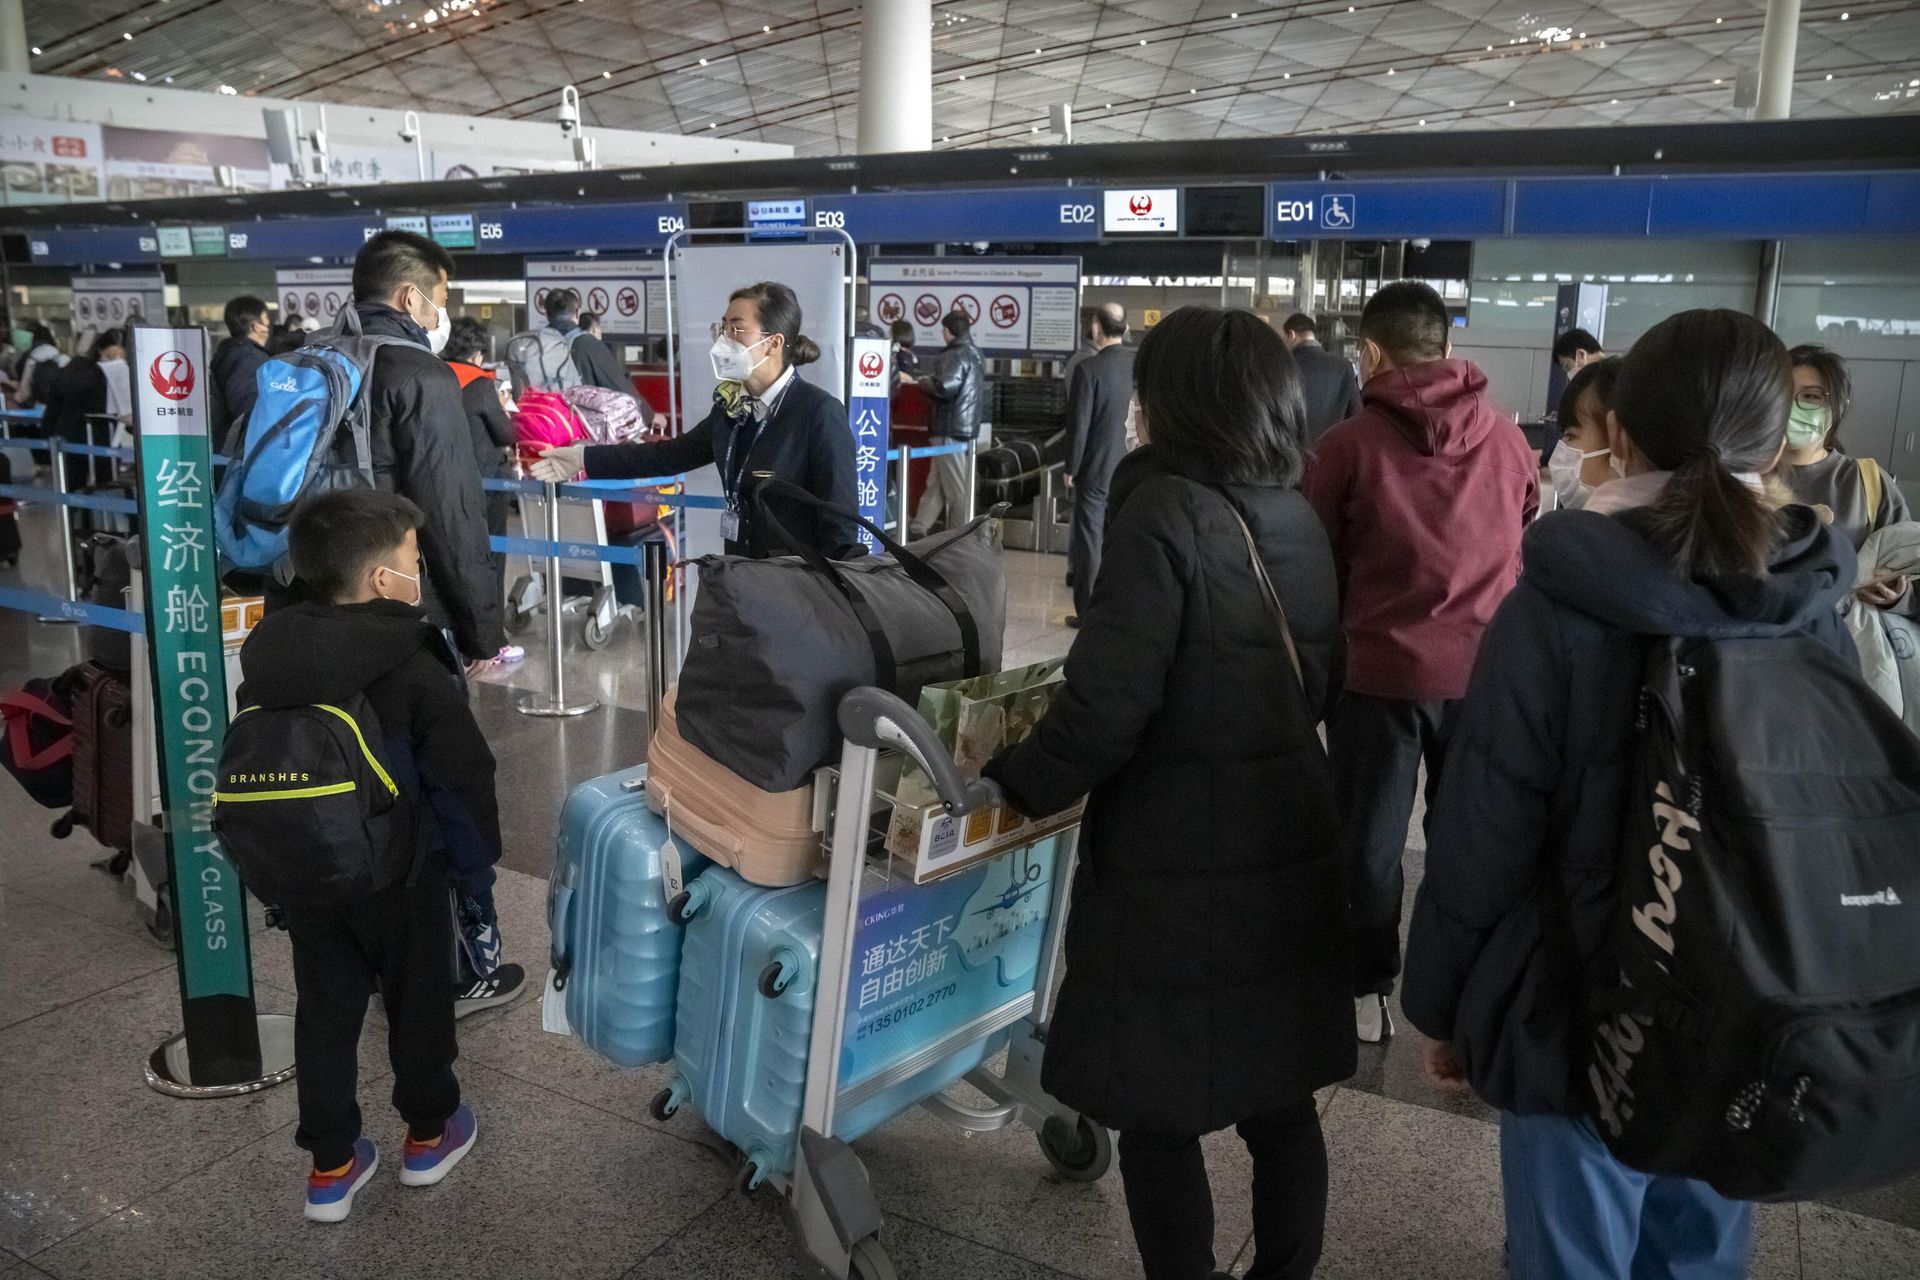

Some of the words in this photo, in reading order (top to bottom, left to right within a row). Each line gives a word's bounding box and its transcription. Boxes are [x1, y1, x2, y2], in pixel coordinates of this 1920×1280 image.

[815, 211, 845, 228] E03
[1060, 204, 1095, 223] E02
[1277, 201, 1313, 221] E01
[480, 223, 503, 239] E05
[658, 216, 685, 233] E04
[165, 386, 189, 395] JAL
[157, 407, 194, 417] 日本航空
[856, 408, 882, 507] 公务舱
[155, 457, 209, 633] 经济舱
[230, 773, 309, 783] BRANSHES
[177, 651, 224, 861] ECONOMY
[201, 867, 227, 951] CLASS
[861, 914, 954, 977] 通达天下
[859, 946, 949, 1009] 自由创新
